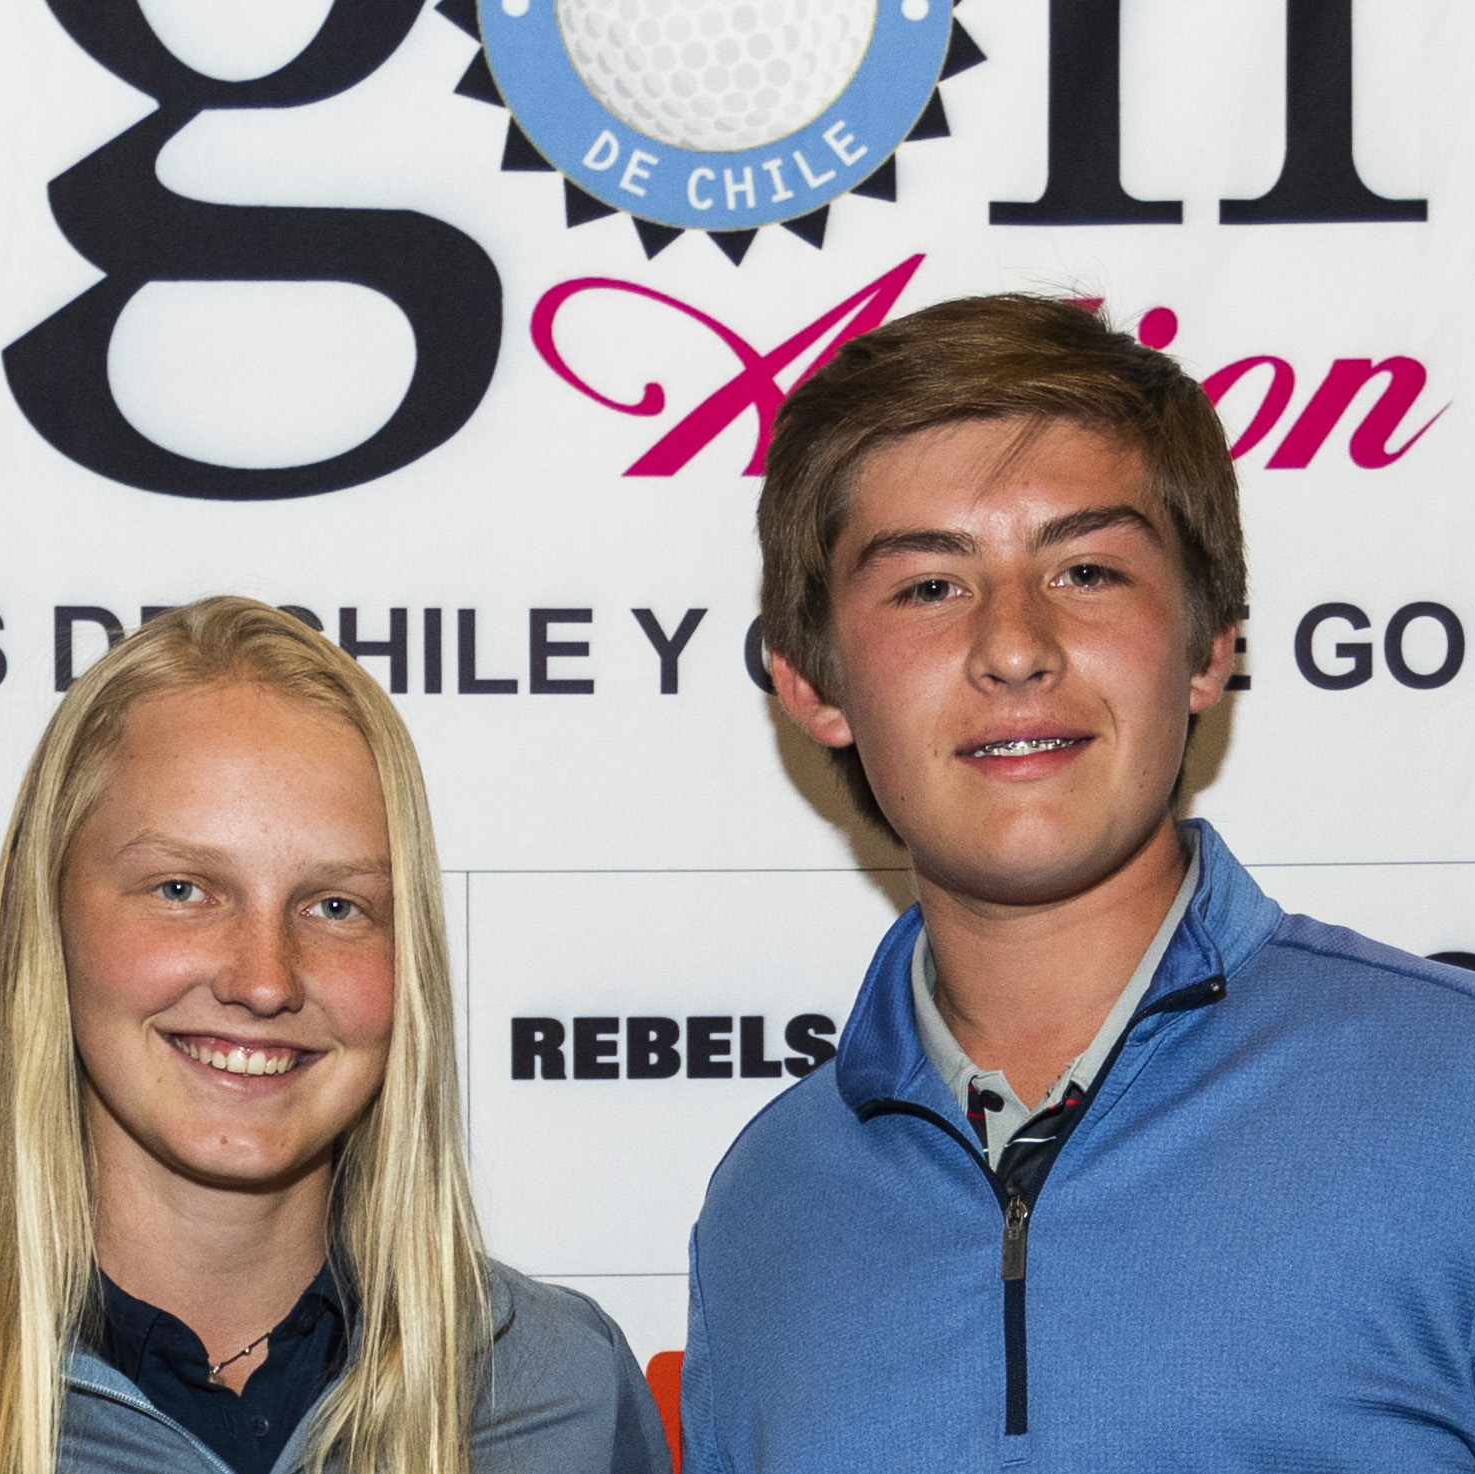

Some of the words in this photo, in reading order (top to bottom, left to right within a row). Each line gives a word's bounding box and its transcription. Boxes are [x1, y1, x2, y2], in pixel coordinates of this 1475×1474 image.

[581, 129, 659, 197] DE
[686, 119, 869, 211] CHILE
[276, 604, 595, 695] HILE
[630, 607, 708, 695] Y
[511, 1013, 837, 1081] REBELS
